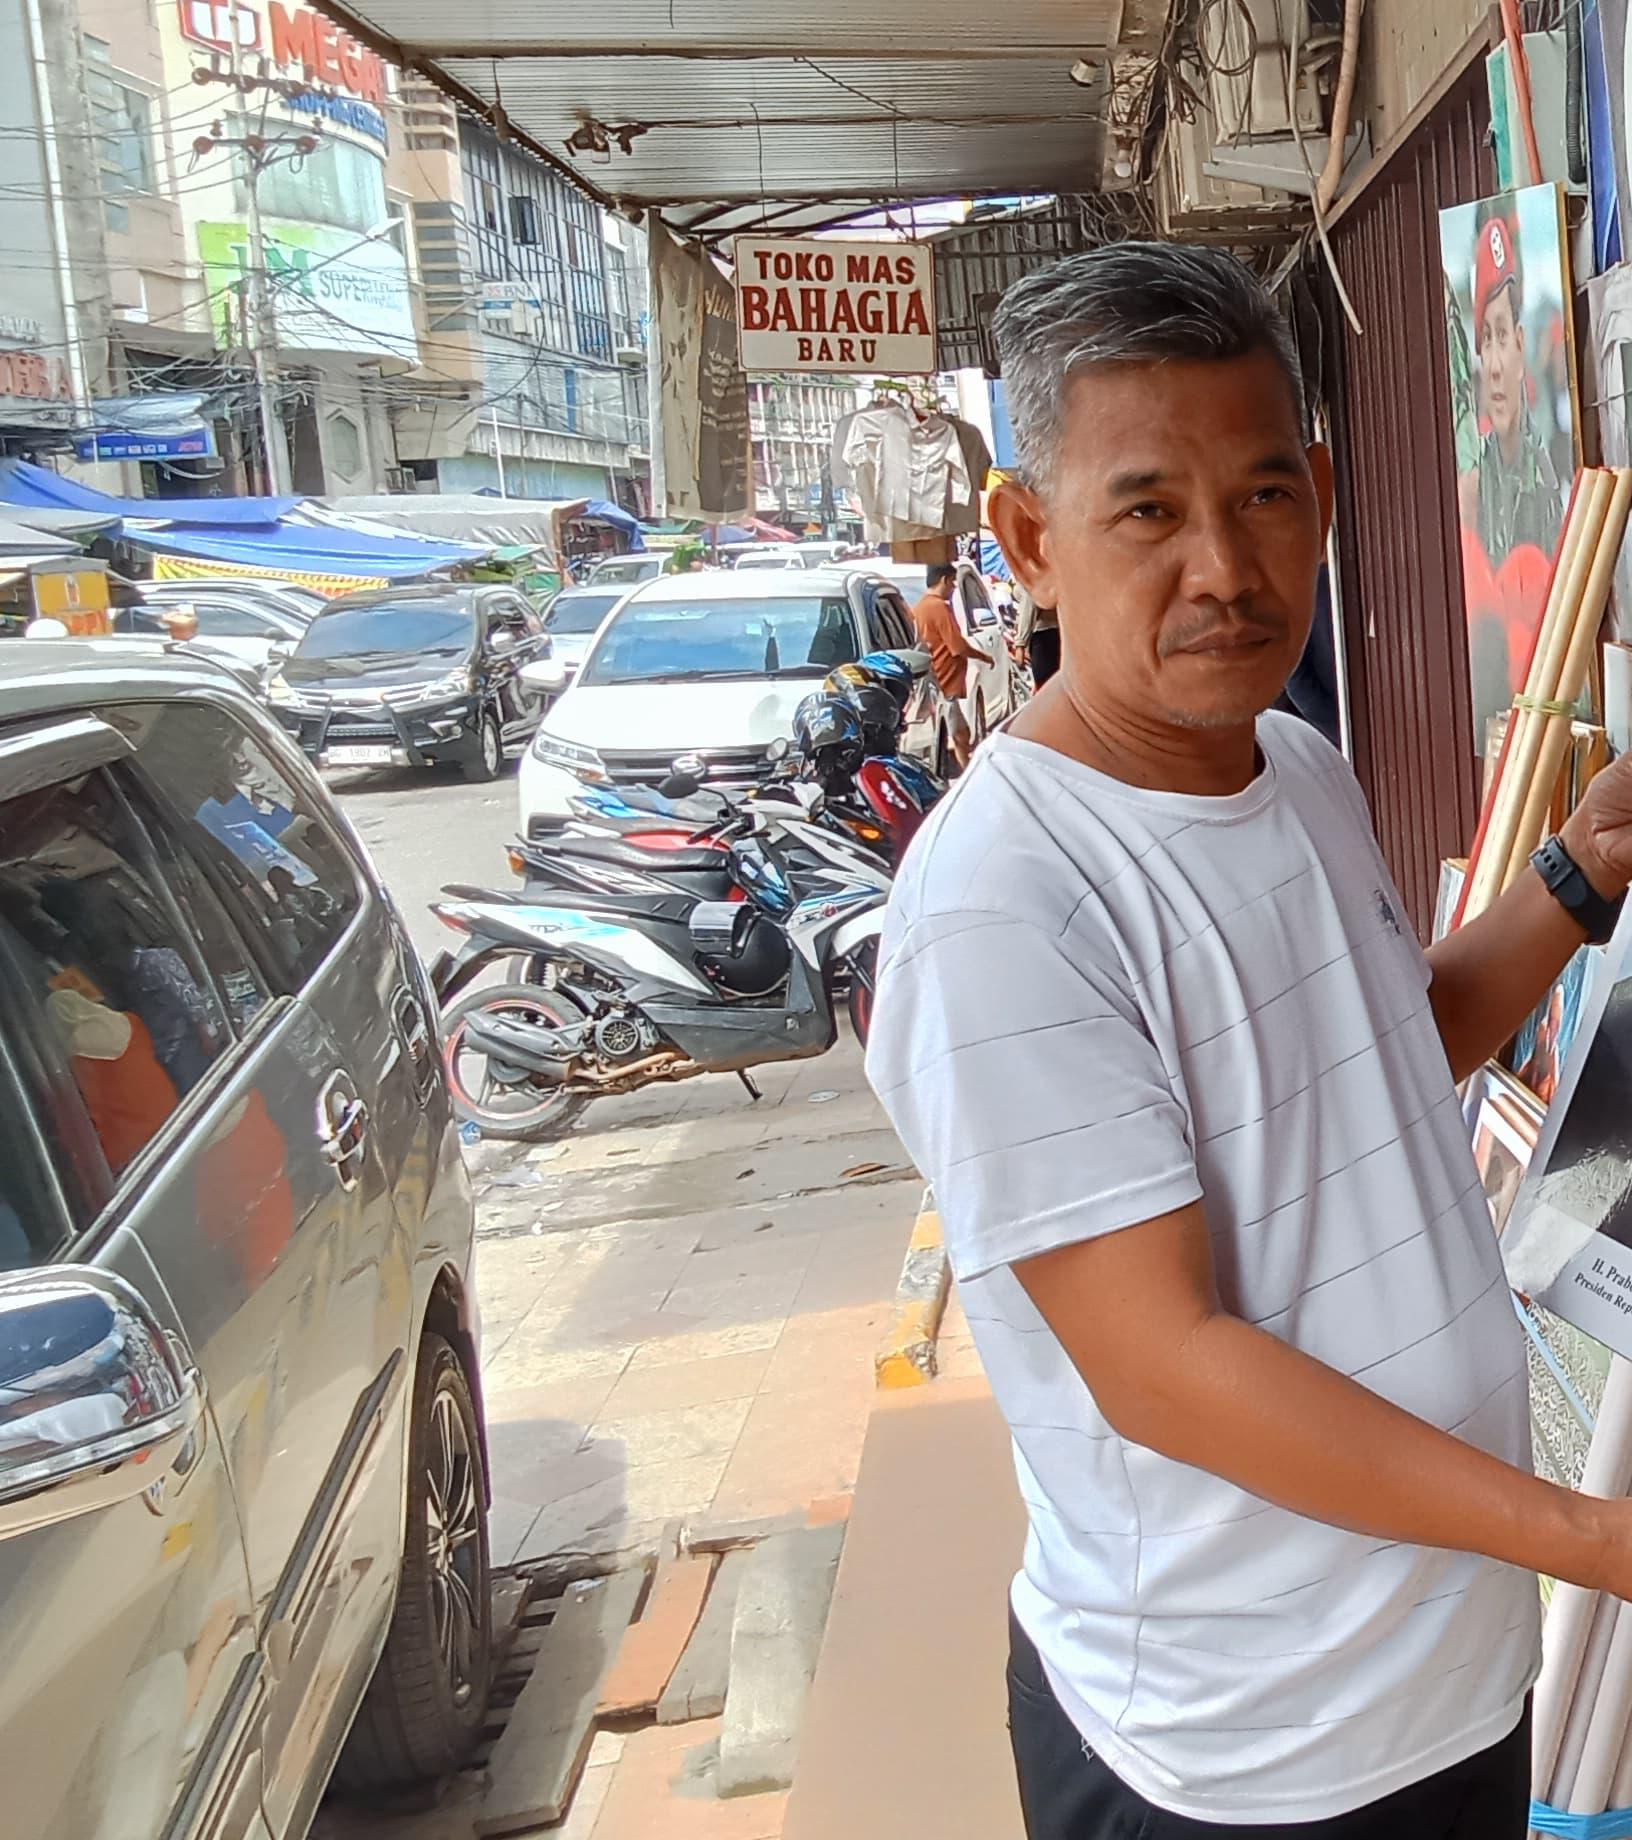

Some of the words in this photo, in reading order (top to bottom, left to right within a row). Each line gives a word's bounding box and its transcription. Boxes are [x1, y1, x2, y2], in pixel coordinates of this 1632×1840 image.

[754, 251, 834, 282] TOKO
[847, 255, 916, 285] MAS
[741, 286, 931, 335] BAHAGIA
[797, 338, 877, 363] BARU
[1592, 1258, 1605, 1276] H.
[1574, 1272, 1613, 1303] Presiden
